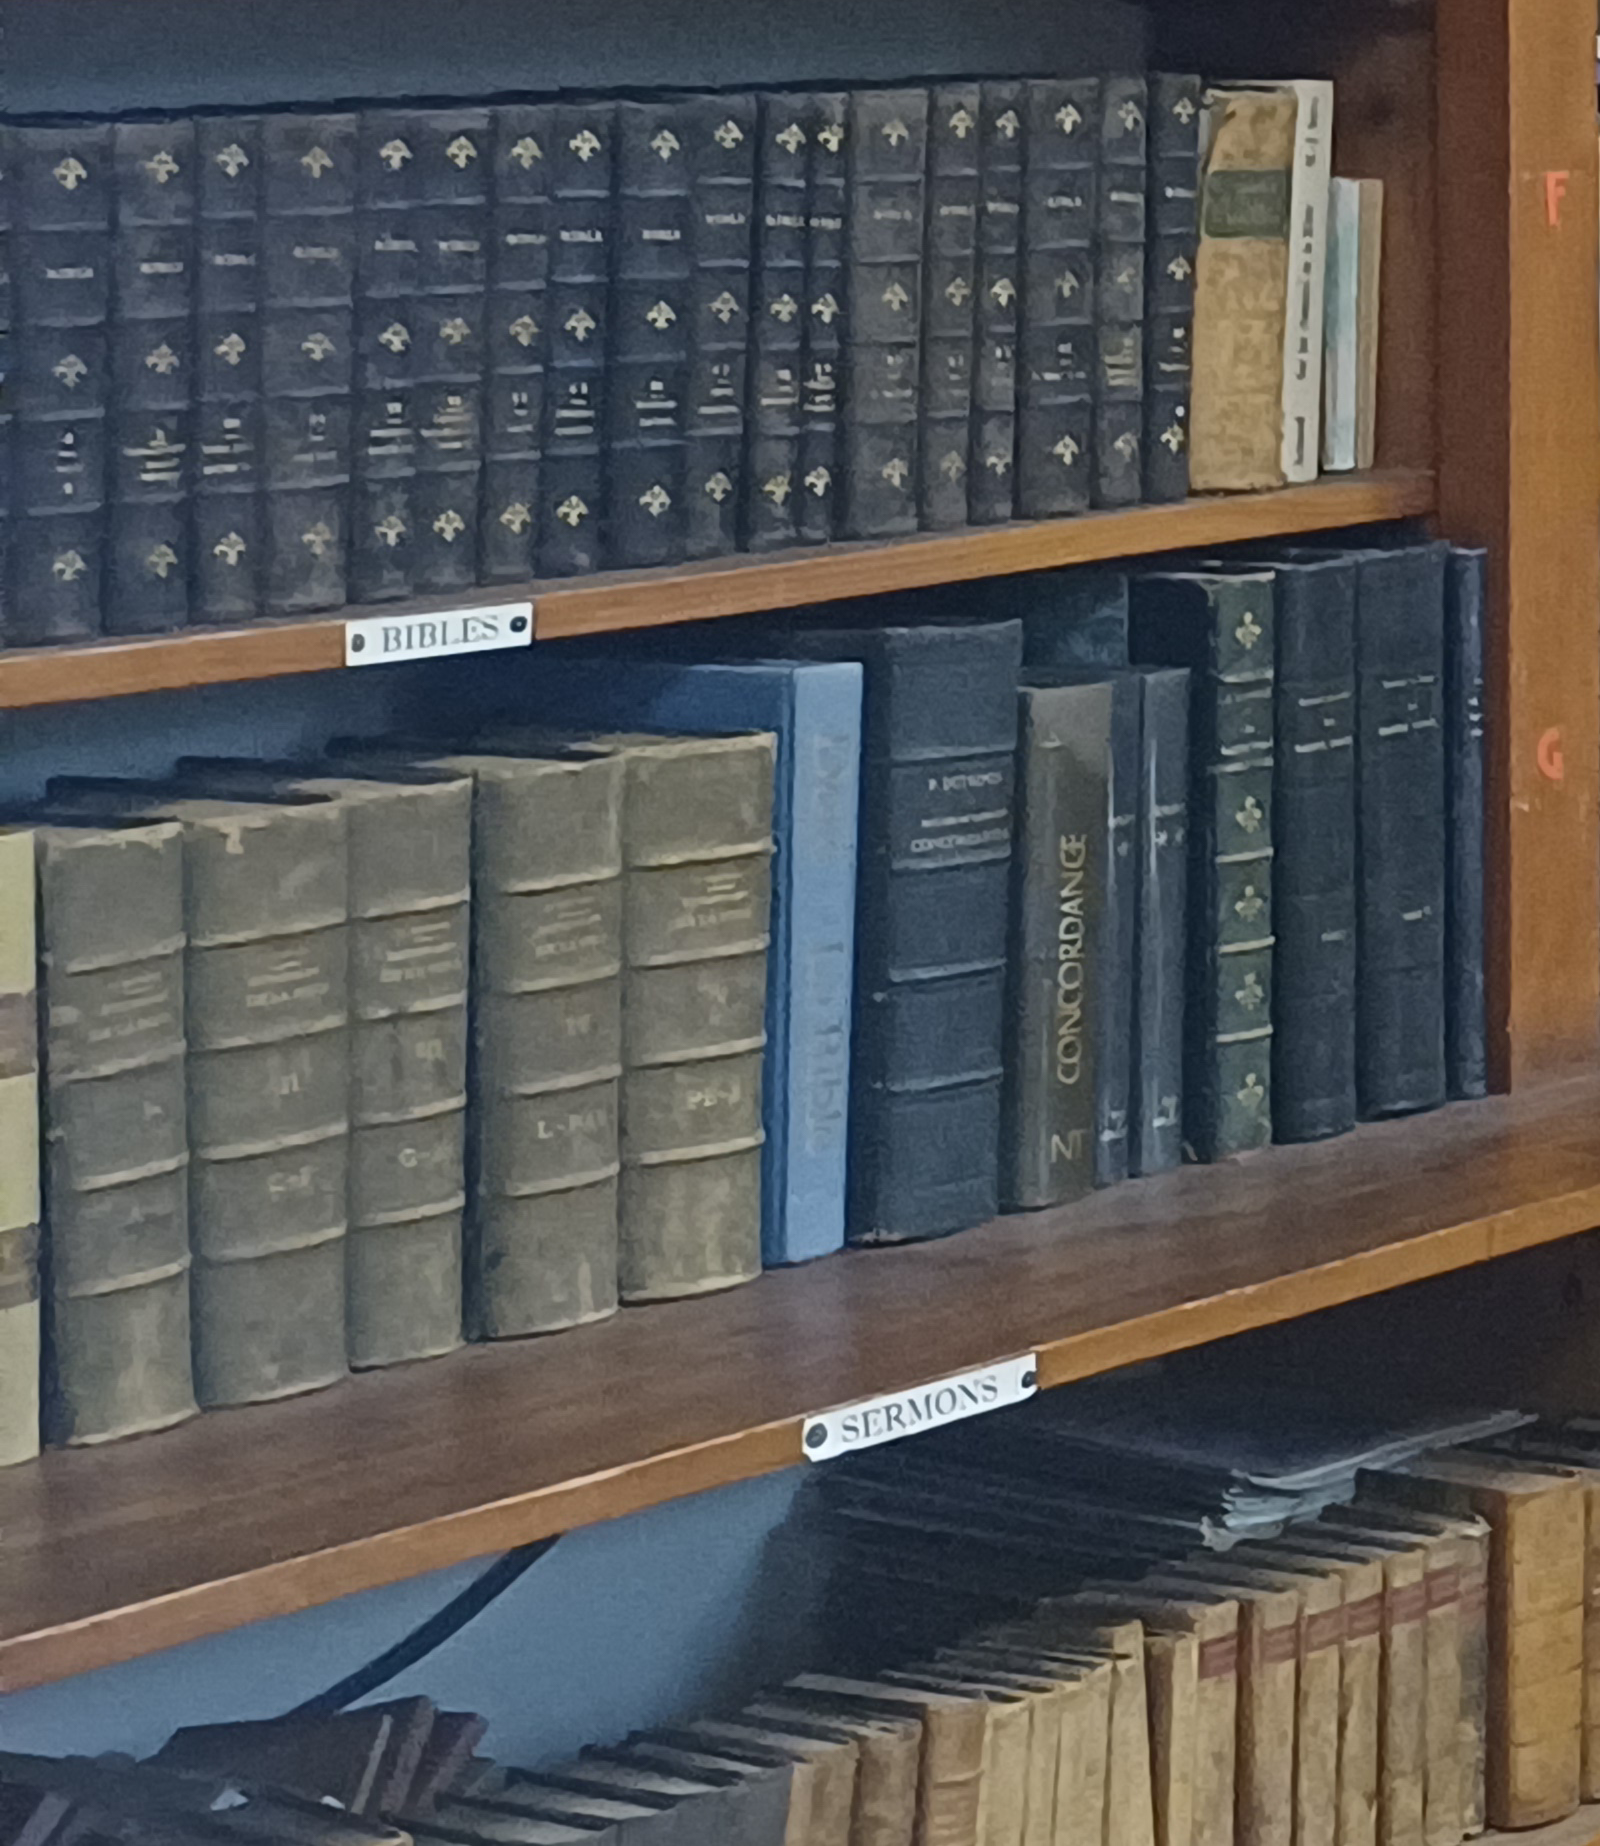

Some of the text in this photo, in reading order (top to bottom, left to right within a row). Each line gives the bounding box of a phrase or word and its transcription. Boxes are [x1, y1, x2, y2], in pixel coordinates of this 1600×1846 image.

[1544, 173, 1566, 225] F
[381, 615, 500, 654] BIBLES
[1537, 727, 1564, 780] G
[1055, 833, 1088, 1086] CONCORDANCE
[840, 1375, 999, 1443] SERMONS
